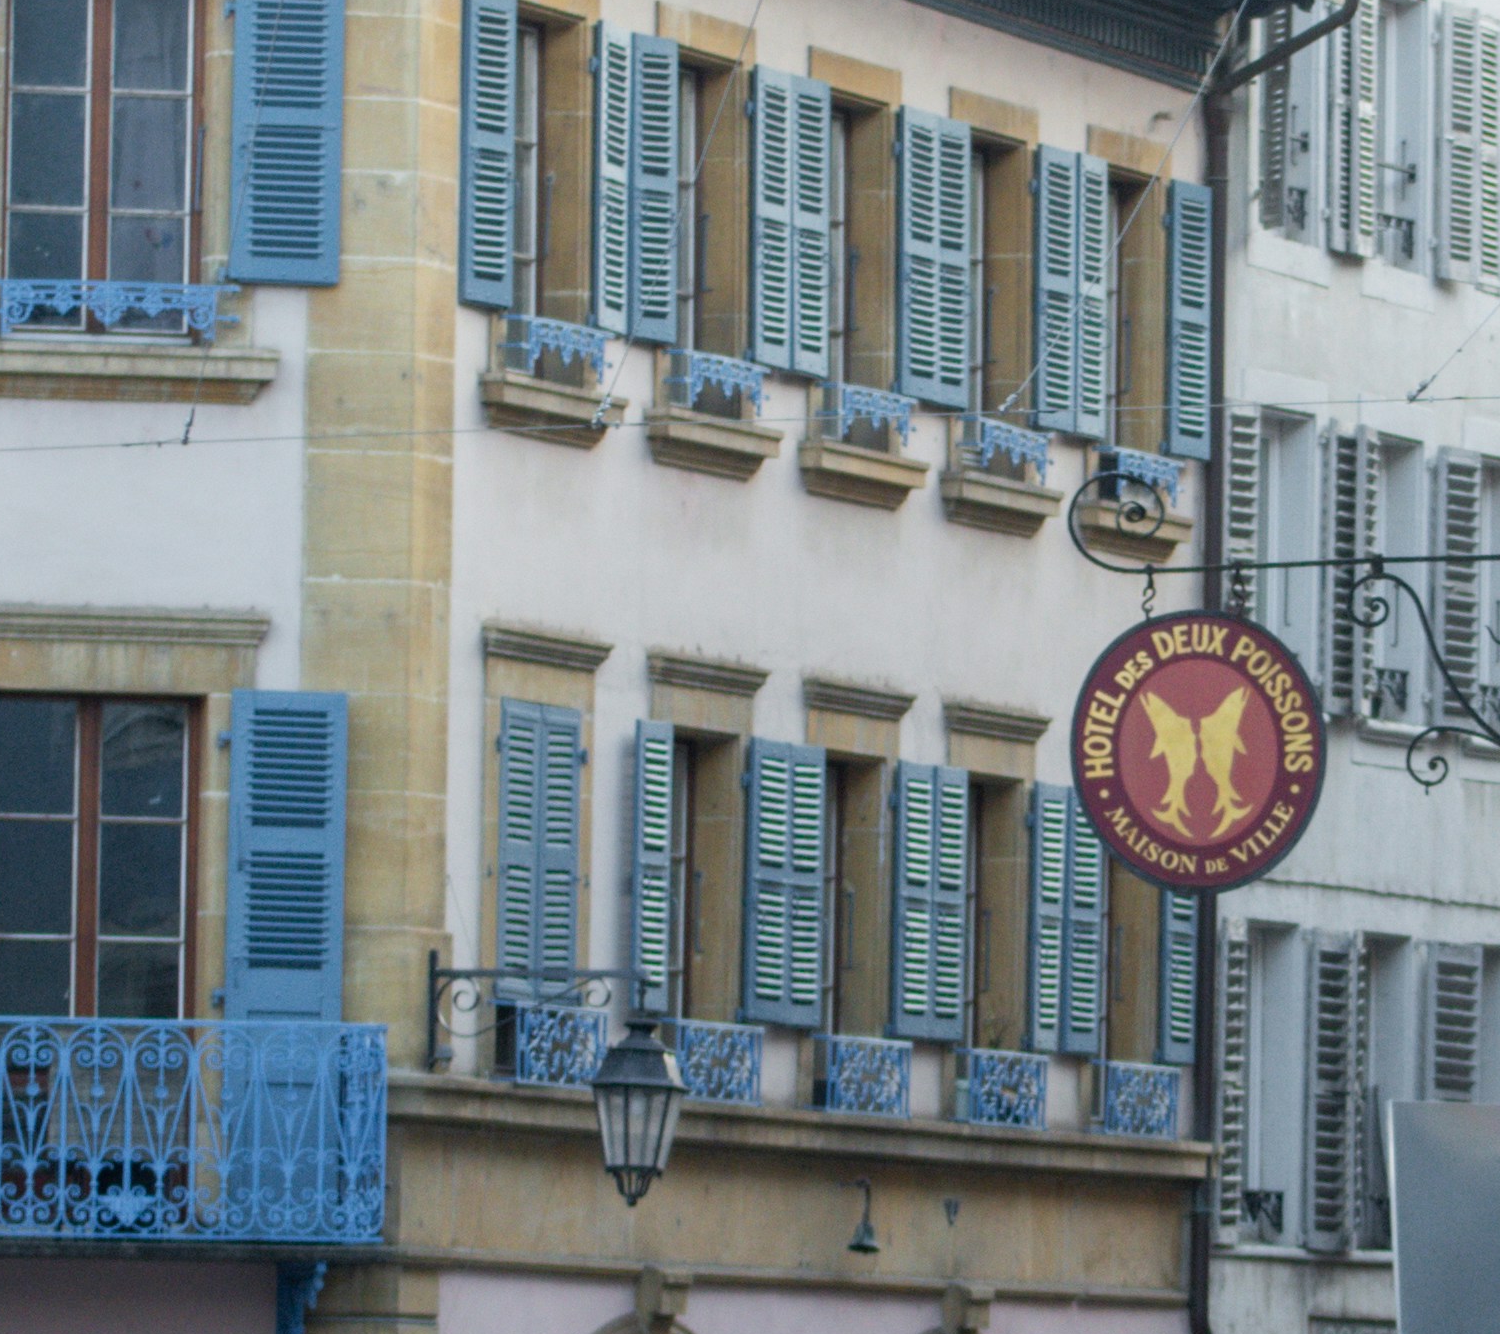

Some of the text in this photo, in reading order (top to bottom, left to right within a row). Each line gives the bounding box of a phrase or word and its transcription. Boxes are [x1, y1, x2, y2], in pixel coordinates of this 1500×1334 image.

[1082, 624, 1313, 779] HOTEL DES DEUX POISSONS
[1104, 801, 1294, 874] MAISON DE VILLE
